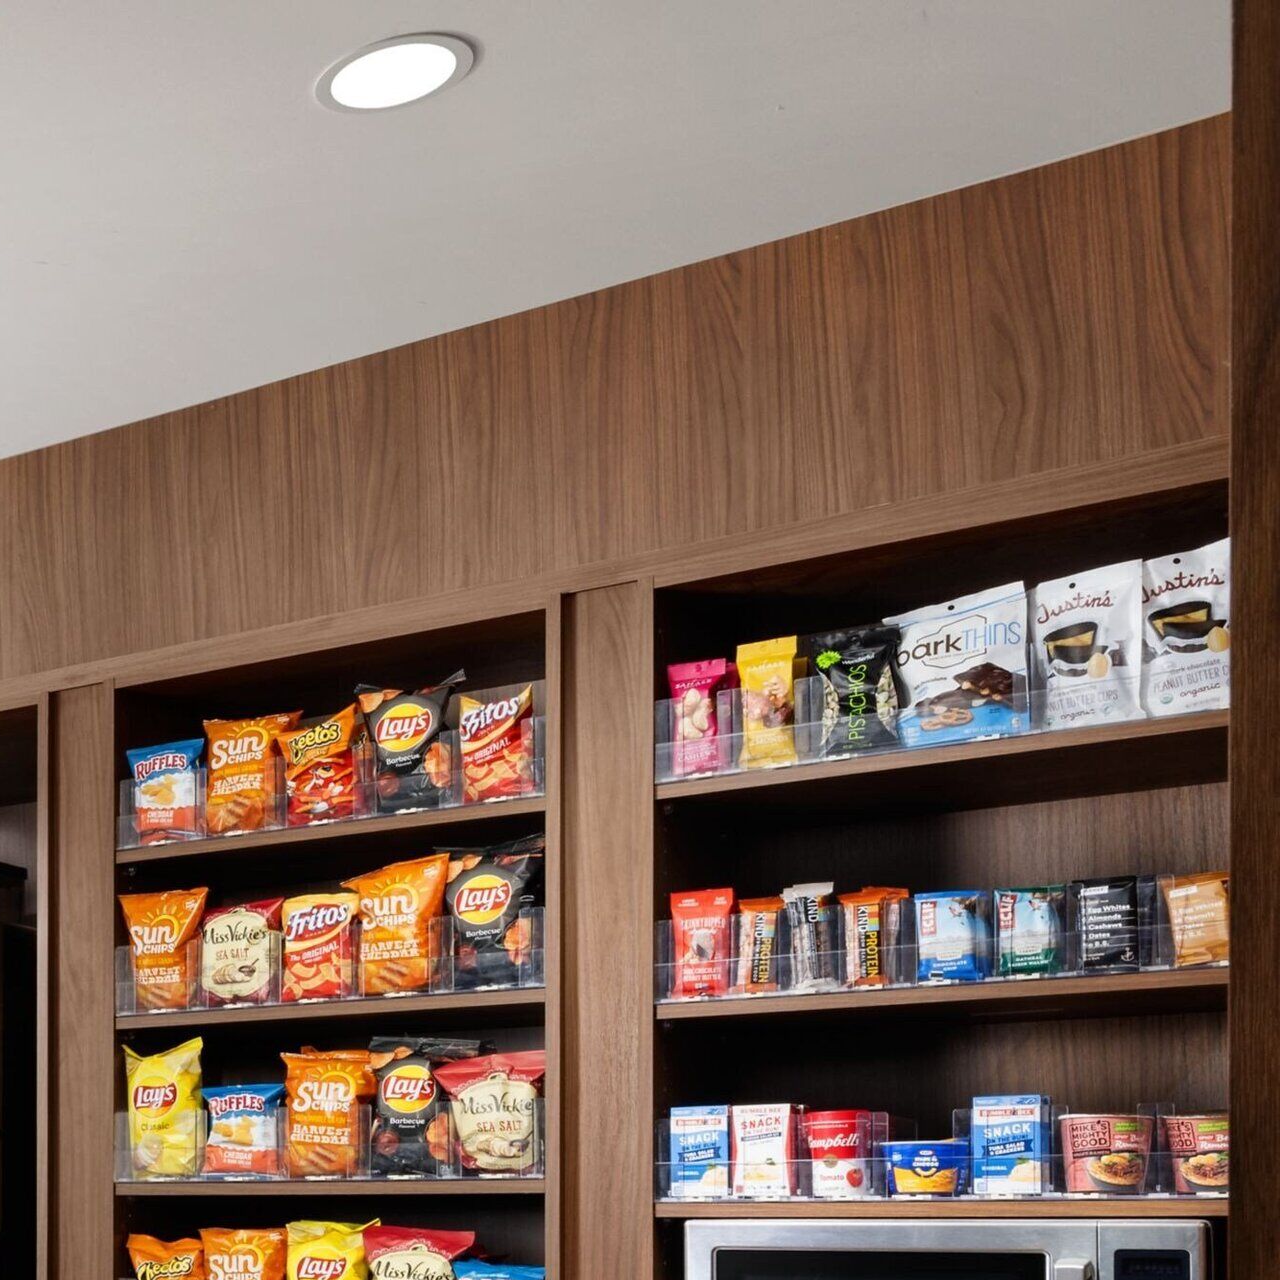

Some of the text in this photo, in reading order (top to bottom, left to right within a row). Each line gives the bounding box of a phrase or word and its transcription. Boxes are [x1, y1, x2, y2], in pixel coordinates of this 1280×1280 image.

[1143, 568, 1224, 603] Justin's
[1037, 591, 1113, 624] Justin's
[842, 653, 875, 665] Wonderful
[1186, 670, 1220, 686] BUTTER
[1180, 682, 1221, 698] organic
[848, 664, 867, 740] PISTACHIOS
[379, 713, 430, 741] Lay's
[460, 697, 520, 741] Fritos
[211, 735, 266, 770] Sun
[290, 722, 340, 764] eetos
[474, 737, 510, 760] ORIGINAL
[136, 754, 186, 779] RUFFLES
[228, 751, 263, 764] CHIPS
[386, 754, 419, 765] Barbecue
[459, 885, 508, 912] Lay's
[1103, 904, 1130, 912] Whites
[361, 895, 418, 930] Sun
[807, 896, 818, 922] KIND
[1089, 913, 1121, 922] Almonds
[287, 904, 349, 940] Fritos
[377, 915, 416, 926] CHIPS
[755, 913, 764, 937] KIND
[857, 906, 868, 932] KIND
[1089, 922, 1122, 930] Cashews
[131, 926, 177, 956] Sun
[228, 921, 267, 945] Vickie's
[466, 928, 500, 937] Barbecue
[144, 943, 174, 954] CHIPS
[216, 948, 249, 960] SEA SALT
[290, 942, 339, 961] The ORIGINAL
[361, 939, 419, 951] HARVEST
[866, 931, 878, 977] PROTEIN
[758, 937, 771, 983] PROTEIN
[136, 1084, 175, 1108] Lay's
[292, 1080, 353, 1112] Sun
[386, 1076, 433, 1100] Lay's
[209, 1095, 264, 1115] RUFFLES
[311, 1100, 350, 1113] CHIPS
[461, 1097, 493, 1115] Miss
[293, 1124, 351, 1137] HARVEST
[477, 1120, 523, 1133] SEA SALT
[741, 1116, 781, 1130] SNACK
[984, 1123, 1031, 1137] SNACK
[1072, 1121, 1108, 1132] MIKE'S
[679, 1133, 719, 1145] SNACK
[1073, 1138, 1107, 1148] GOOD
[299, 1256, 345, 1280] Lay's
[374, 1261, 406, 1278] Miss
